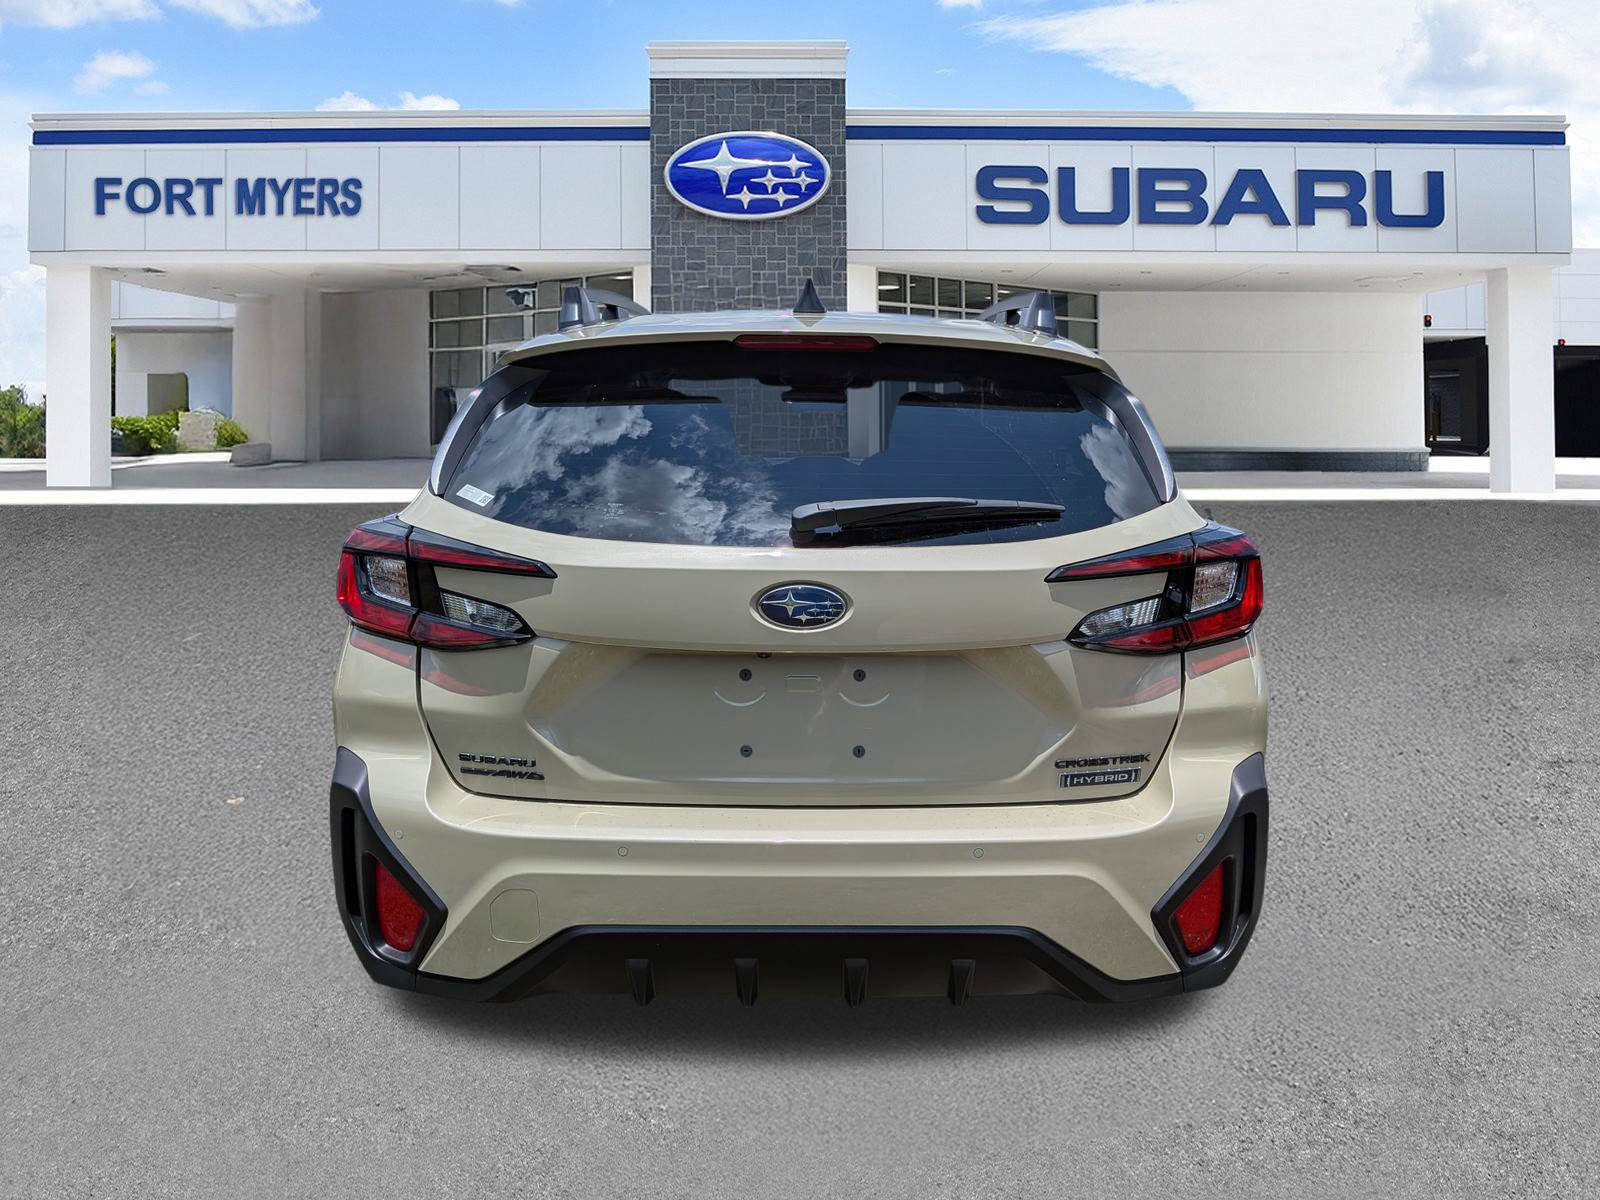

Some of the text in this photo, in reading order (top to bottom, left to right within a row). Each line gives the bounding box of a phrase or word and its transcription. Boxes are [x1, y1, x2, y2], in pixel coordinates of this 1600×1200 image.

[94, 177, 363, 217] FORT MYERS
[975, 165, 1445, 228] SUBARU
[458, 752, 537, 768] SUBARU
[1055, 753, 1151, 769] CROSSTREK
[1073, 772, 1128, 785] HYBRID
